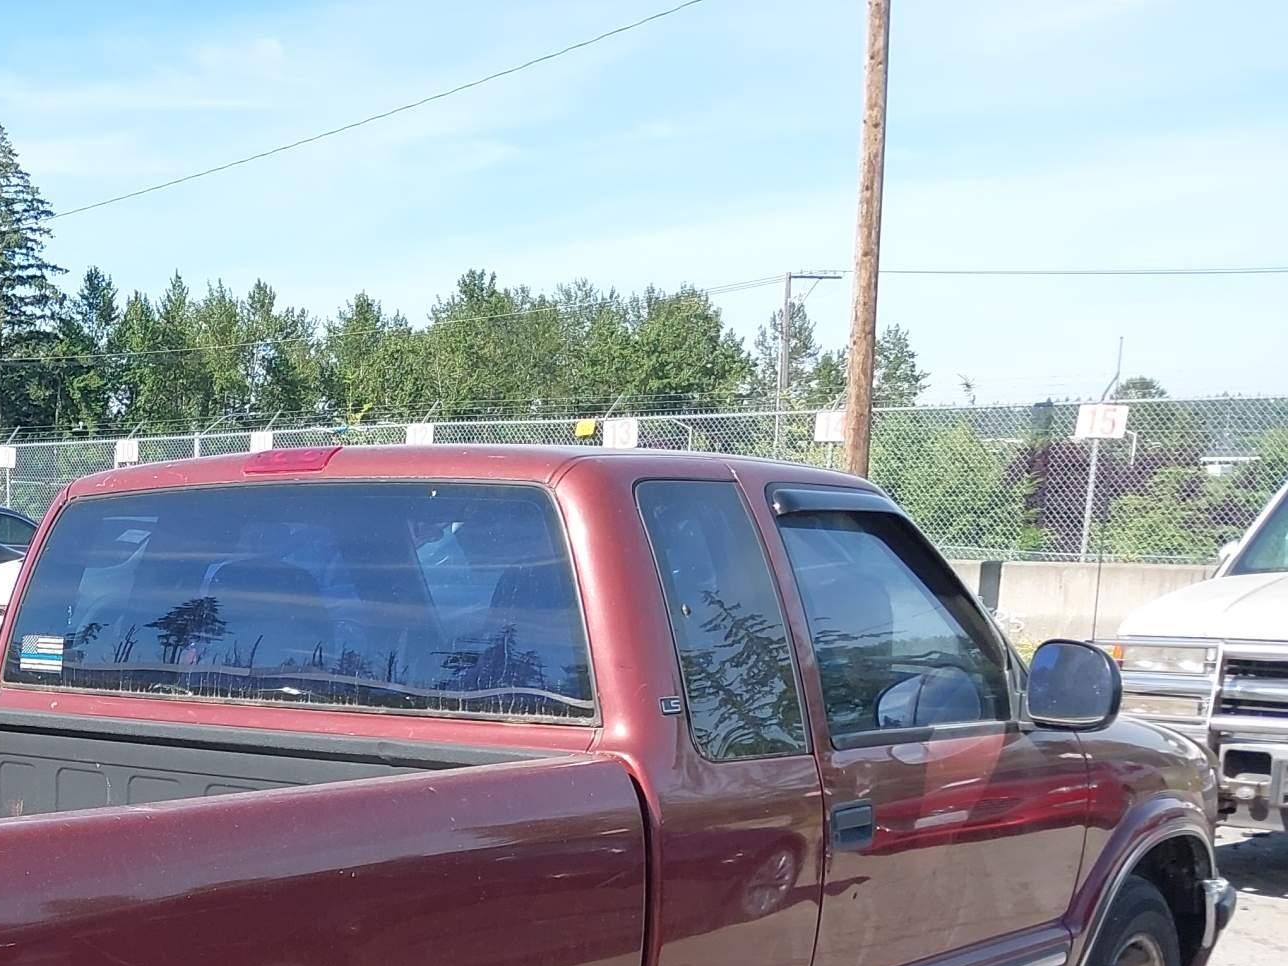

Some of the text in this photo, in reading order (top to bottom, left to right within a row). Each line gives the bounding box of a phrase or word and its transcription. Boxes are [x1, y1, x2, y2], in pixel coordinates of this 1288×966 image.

[611, 421, 631, 447] 13
[1087, 407, 1117, 435] 15
[661, 699, 681, 713] LS
